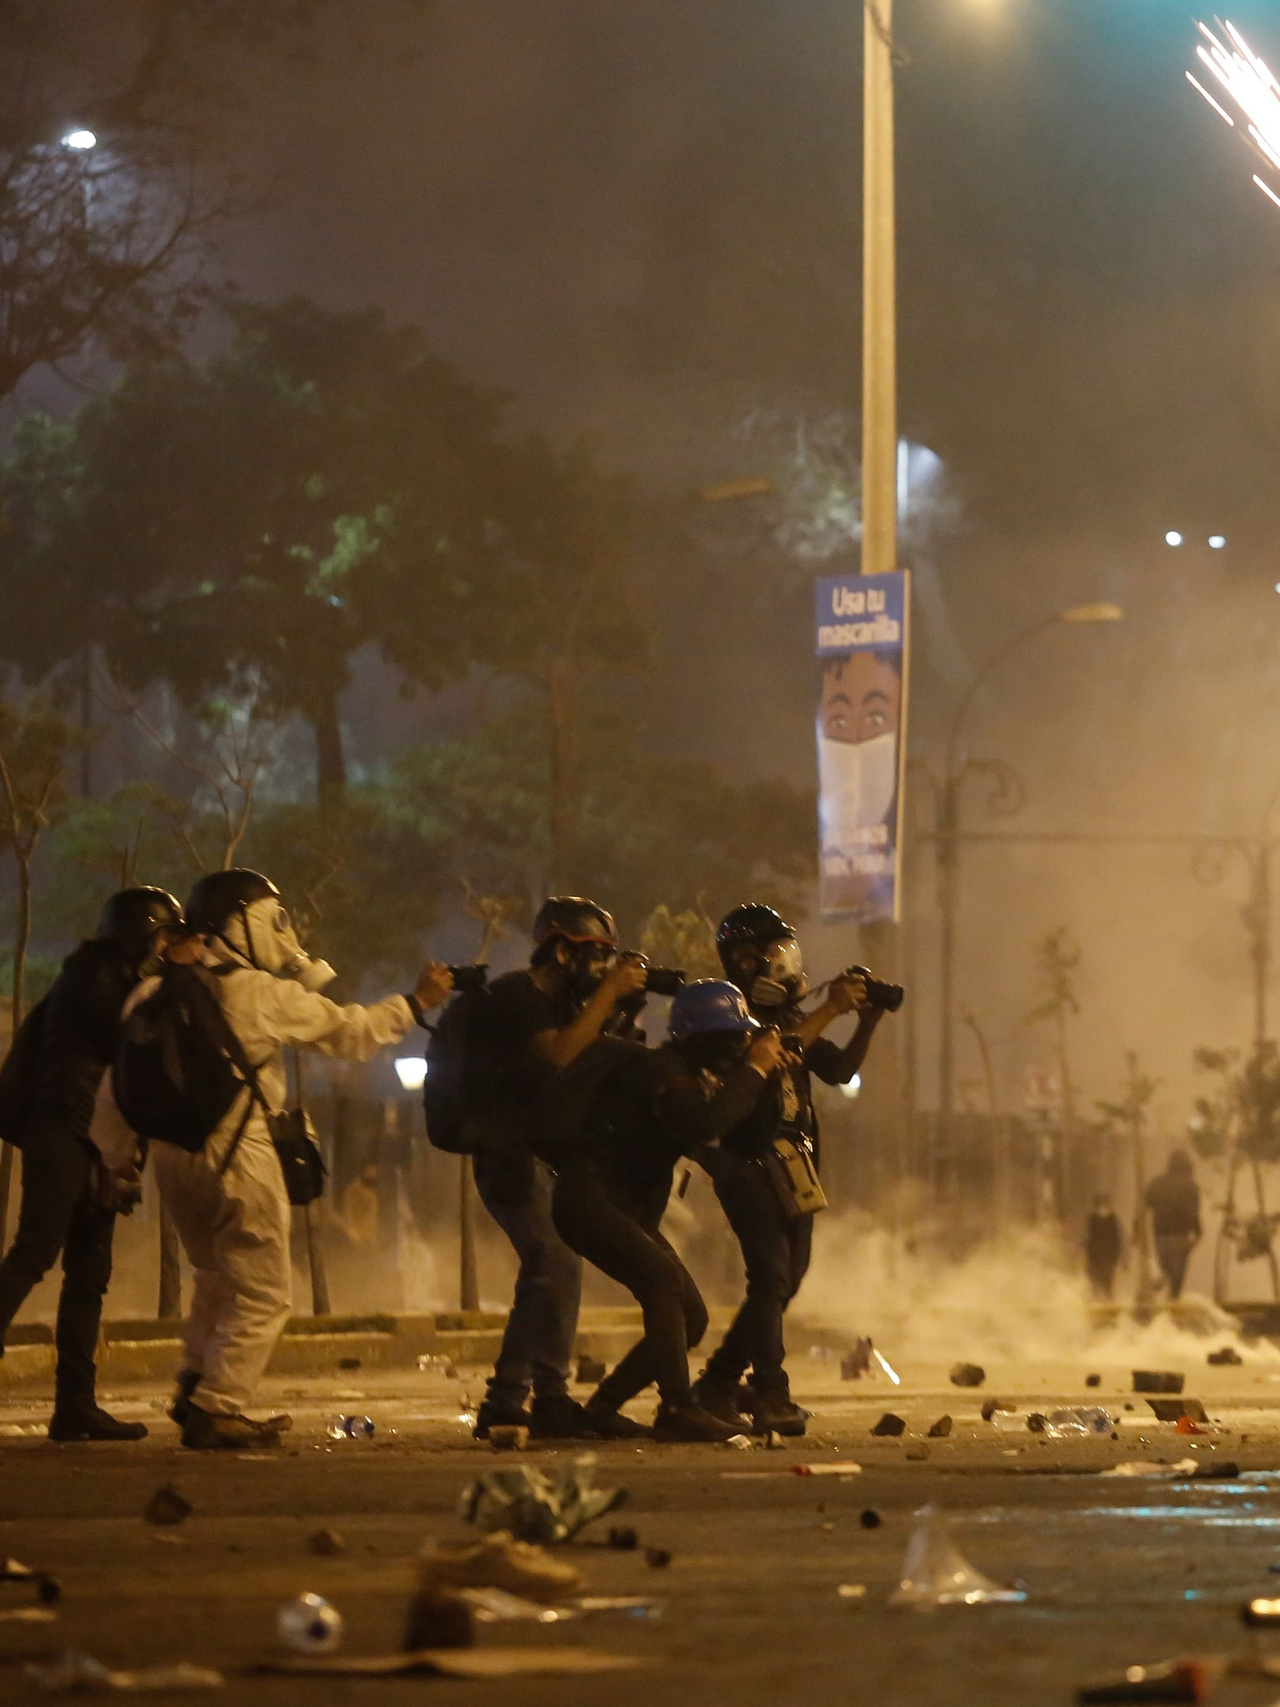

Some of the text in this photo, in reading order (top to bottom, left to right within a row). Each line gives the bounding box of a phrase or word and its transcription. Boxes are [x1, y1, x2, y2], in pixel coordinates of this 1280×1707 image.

[832, 586, 886, 616] Usa tu
[818, 613, 900, 648] mascarilla
